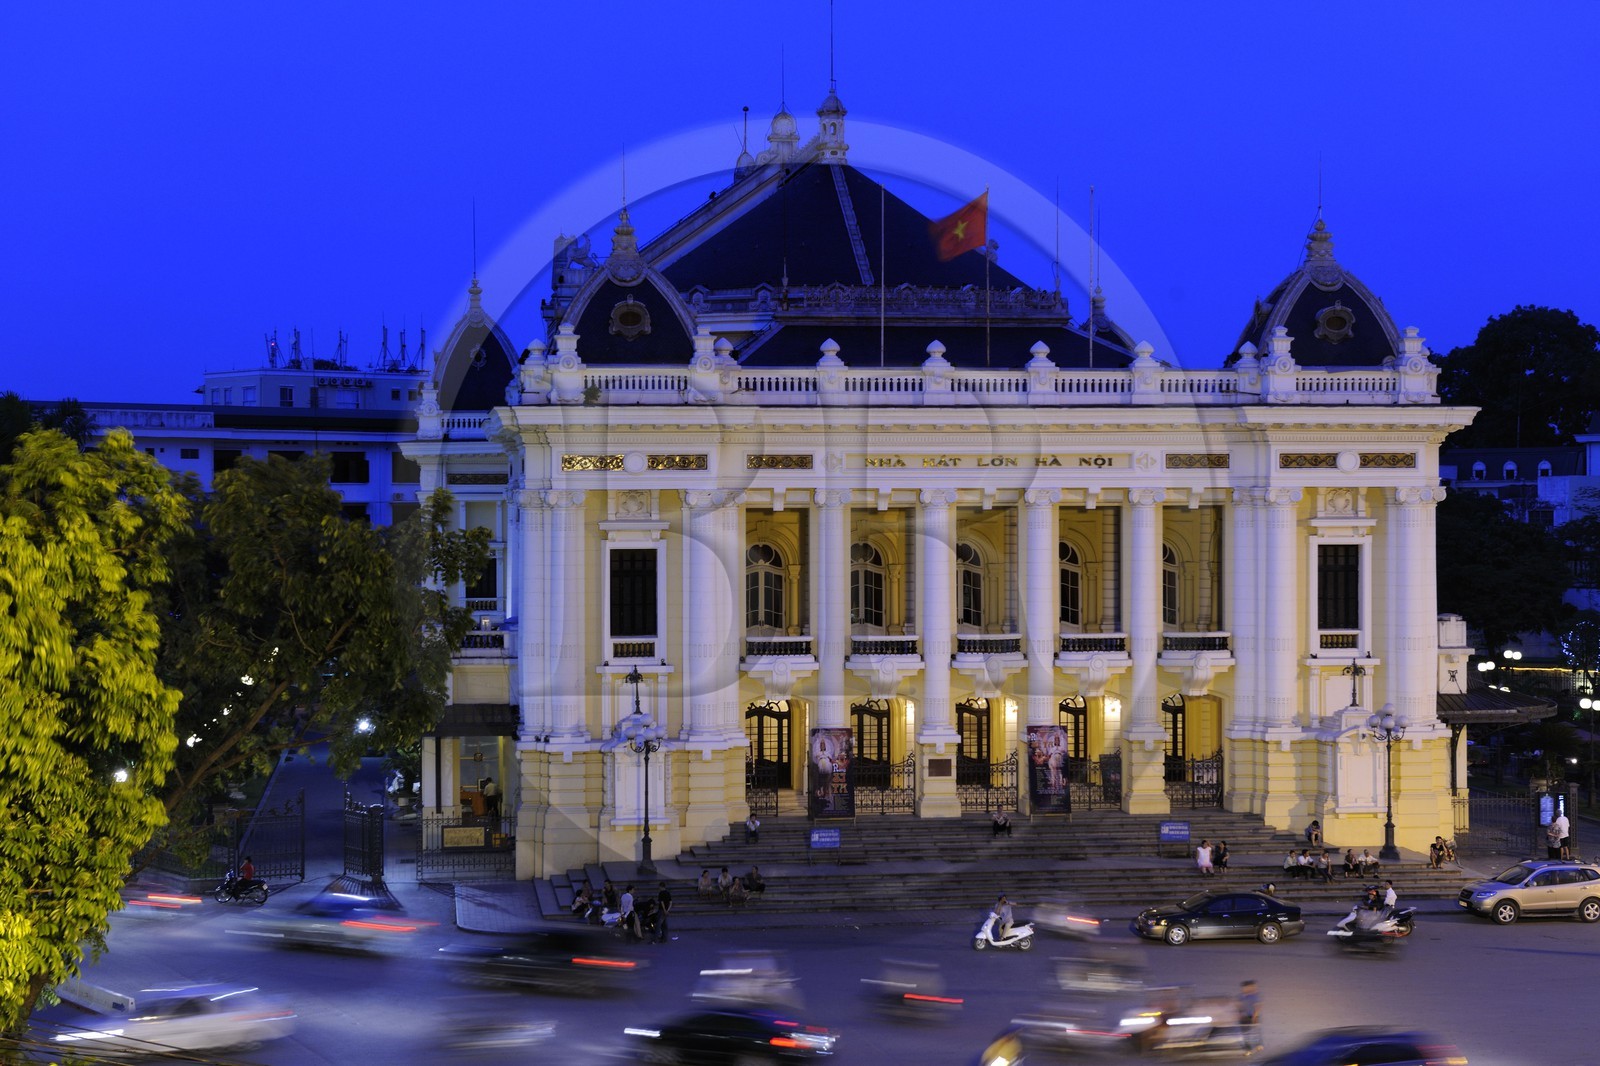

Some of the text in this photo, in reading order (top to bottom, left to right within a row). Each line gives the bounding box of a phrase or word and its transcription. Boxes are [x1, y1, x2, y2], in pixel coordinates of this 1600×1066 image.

[865, 454, 906, 467] NHÀ
[977, 455, 1018, 467] LỚN
[1035, 455, 1062, 466] HÀ
[1079, 455, 1112, 468] NỘI
